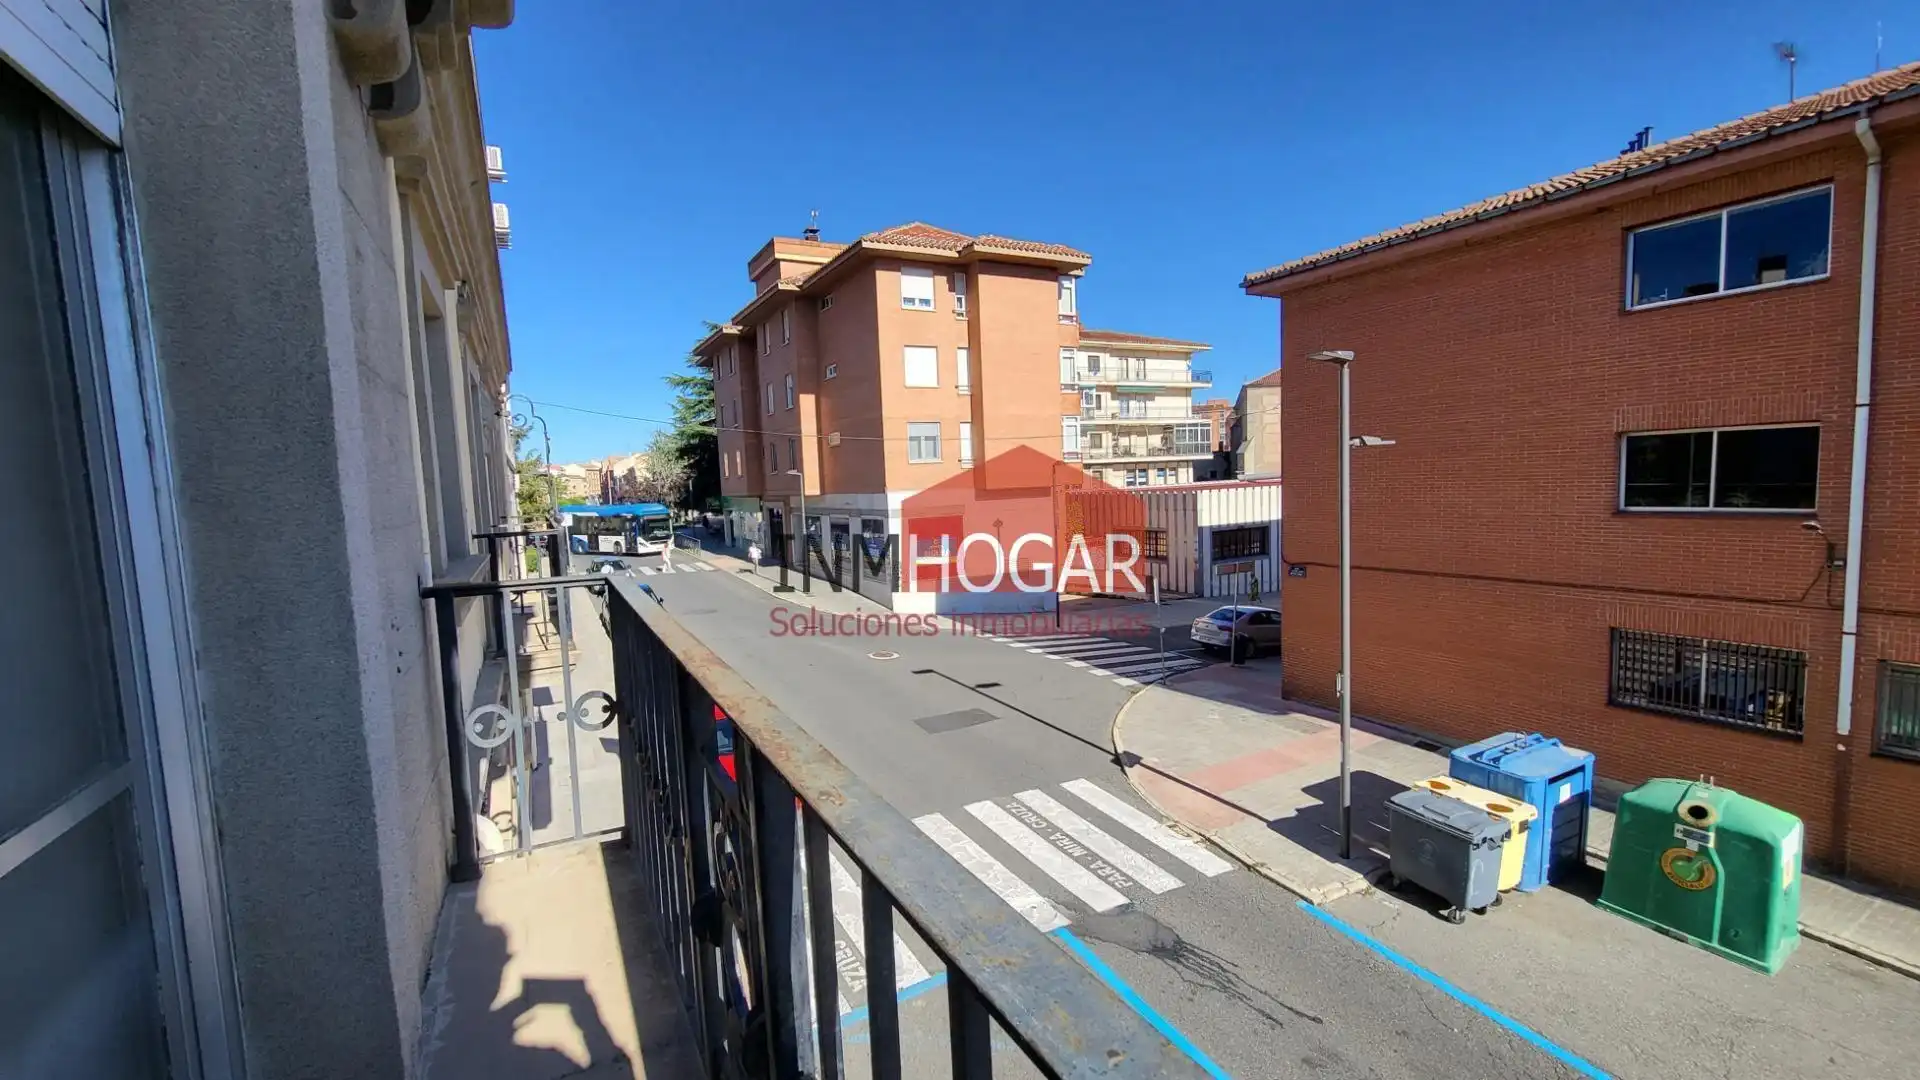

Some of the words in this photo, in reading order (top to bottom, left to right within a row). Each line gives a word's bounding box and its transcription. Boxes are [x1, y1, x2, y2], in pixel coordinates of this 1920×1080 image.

[1006, 801, 1047, 829] CRUZA
[1049, 831, 1088, 857] MIRA
[1090, 860, 1133, 888] PARA
